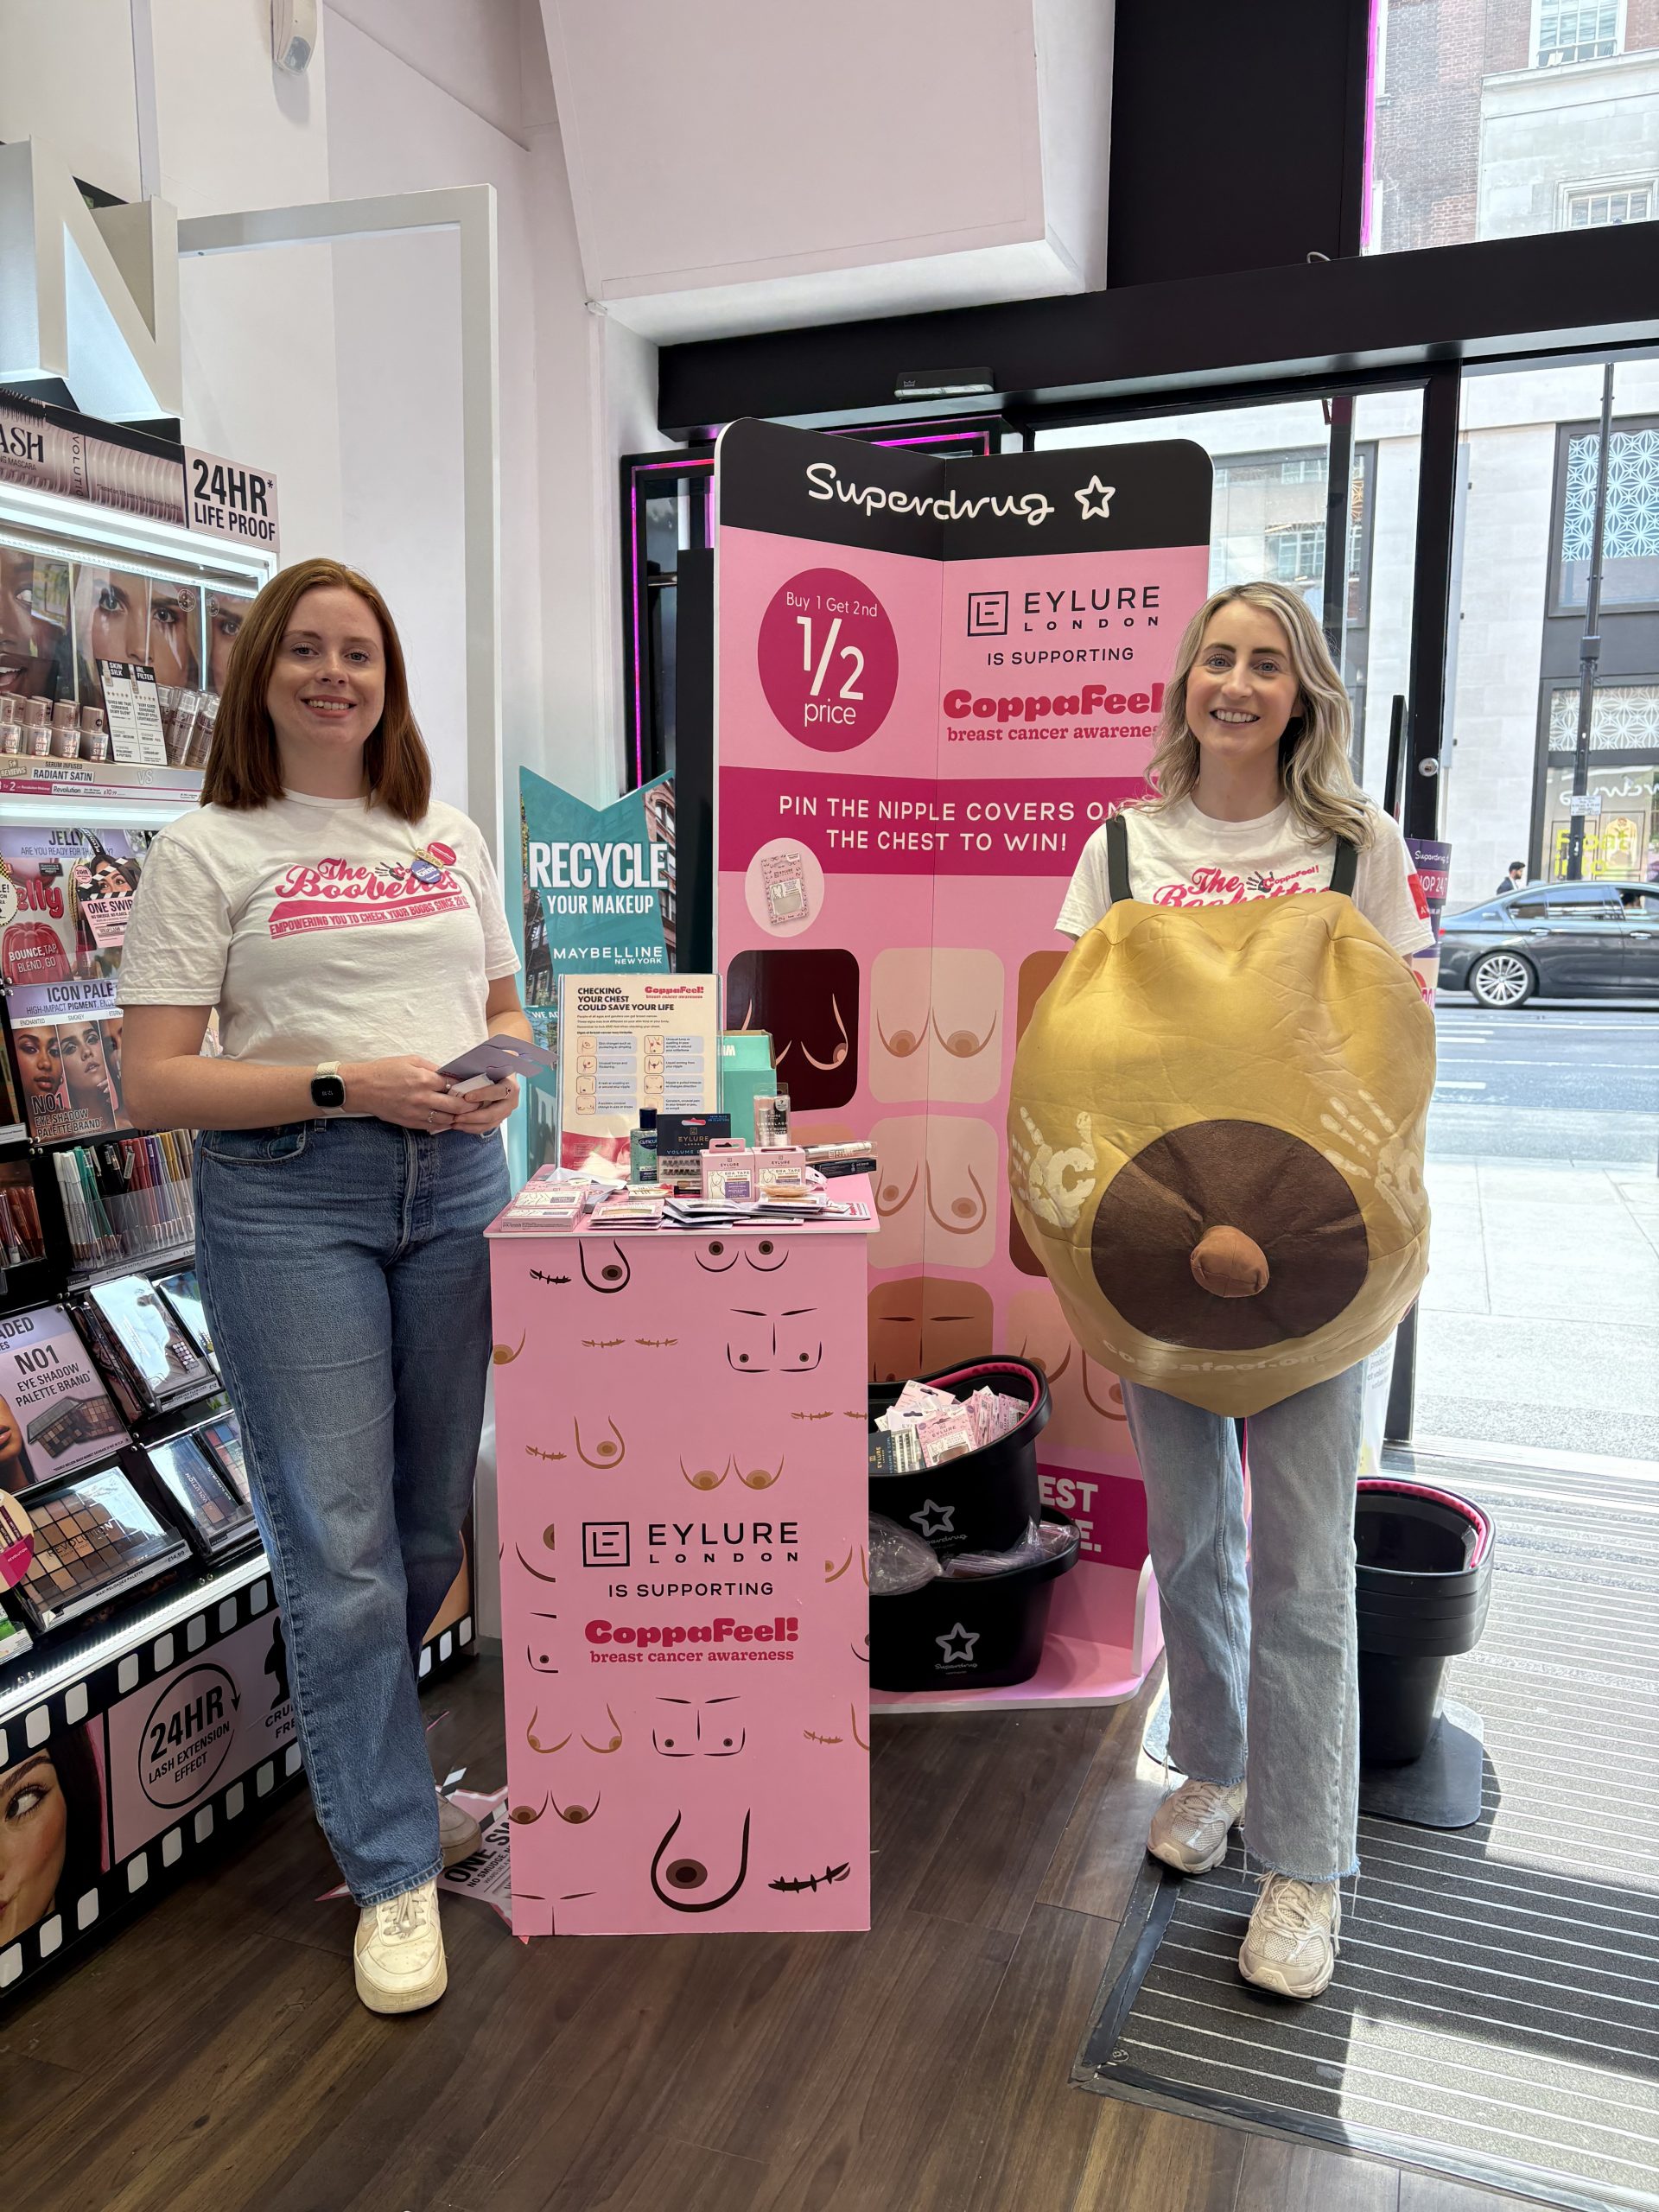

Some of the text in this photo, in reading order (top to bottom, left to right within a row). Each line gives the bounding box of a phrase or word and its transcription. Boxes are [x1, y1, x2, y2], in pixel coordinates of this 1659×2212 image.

[8, 458, 36, 471] MASCARA
[806, 462, 1055, 526] Superdrug
[194, 502, 276, 541] LIFE PROOF
[786, 591, 878, 617] Buy 1 Get 2nd
[1024, 586, 1160, 614] EYLURE
[1024, 616, 1159, 632] LONDON
[797, 615, 864, 701] 1/2
[988, 647, 1134, 666] IS SUPPORTING
[137, 672, 154, 681] FILTER
[804, 698, 856, 728] price
[947, 726, 1003, 741] breast
[1007, 727, 1069, 740] cancer
[34, 769, 92, 782] RADIANT SATIN
[137, 769, 154, 785] VS
[53, 785, 80, 794] Revolution
[779, 795, 817, 816] PIN
[827, 798, 869, 818] THE
[878, 800, 956, 822] NIPPLE
[966, 801, 1076, 822] COVERS
[826, 830, 1067, 852] THE CHEST TO WIN!
[529, 842, 669, 889] RECYCLE
[1414, 850, 1446, 865] Superdrug
[317, 857, 367, 880] The
[1263, 865, 1319, 889] CoppaFeel!
[1187, 868, 1240, 895] The
[17, 880, 64, 919] elly
[87, 901, 109, 913] ONE
[547, 895, 654, 915] YOUR MAKEUP
[269, 914, 328, 936] EMPOWERING
[331, 913, 346, 925] YOU
[348, 914, 359, 924] TO
[361, 910, 387, 923] CHECK
[389, 907, 410, 919] YOUR
[410, 903, 433, 916] BOOBS
[435, 899, 454, 912] SINCE
[46, 957, 56, 967] GO
[554, 947, 663, 959] MAYBELLINE
[48, 985, 80, 1002] ICON
[645, 986, 704, 995] CoppaFeel!
[27, 1002, 67, 1014] HIGH-IMPACT
[31, 1093, 67, 1115] NO1
[35, 1109, 88, 1127] EYE SHADOW
[37, 1123, 73, 1139] PALETTE
[14, 1344, 60, 1375] NO1
[17, 1363, 79, 1392] EYE SHADOW
[16, 1387, 58, 1407] PALETTE
[931, 1426, 957, 1438] EYLURE
[1038, 1474, 1098, 1512] EST
[649, 1522, 798, 1546] EYLURE
[649, 1552, 798, 1564] LONDON
[609, 1582, 773, 1598] IS SUPPORTING
[585, 1617, 799, 1648] CoppaFeel!
[590, 1649, 794, 1663] breast cancer awareness
[150, 1686, 224, 1763] 24HR
[265, 1704, 294, 1728] CRU
[149, 1721, 230, 1783] LASH EXTENSION
[175, 1751, 207, 1783] EFFECT
[467, 1878, 480, 1888] NO
